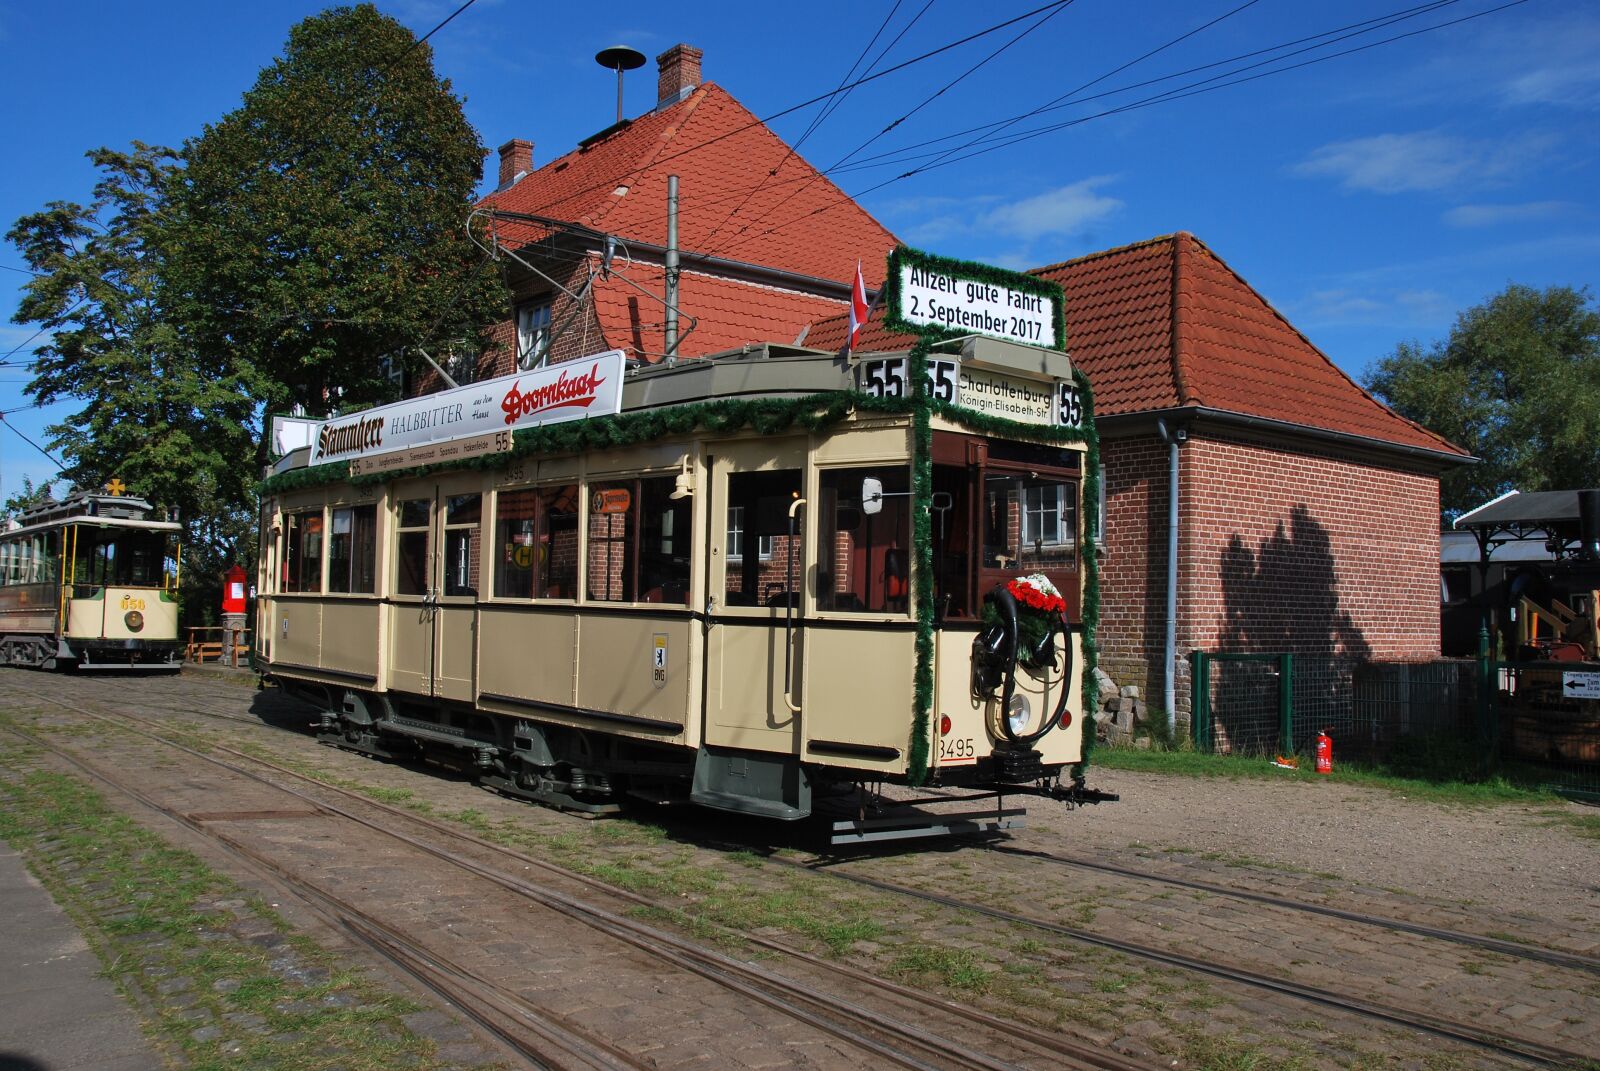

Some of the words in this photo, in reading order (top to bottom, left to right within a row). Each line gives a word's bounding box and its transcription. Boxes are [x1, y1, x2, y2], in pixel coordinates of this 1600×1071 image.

[909, 266, 958, 295] Allzeit
[966, 281, 999, 303] gute
[1007, 288, 1043, 314] Fahrt
[910, 295, 925, 317] 2.
[928, 298, 1008, 334] September
[1010, 316, 1043, 341] 2017
[501, 363, 607, 425] Doornkaat
[866, 359, 903, 399] 55
[959, 373, 1051, 408] Charlottenburg
[959, 393, 1049, 419] Königin-Elisabeth-Str.
[1060, 383, 1081, 427] 55
[316, 415, 385, 460] Stammherr
[391, 402, 463, 435] HALBBITTER
[352, 459, 361, 475] 55
[463, 441, 489, 453] Hakenfelde
[495, 432, 508, 452] 55
